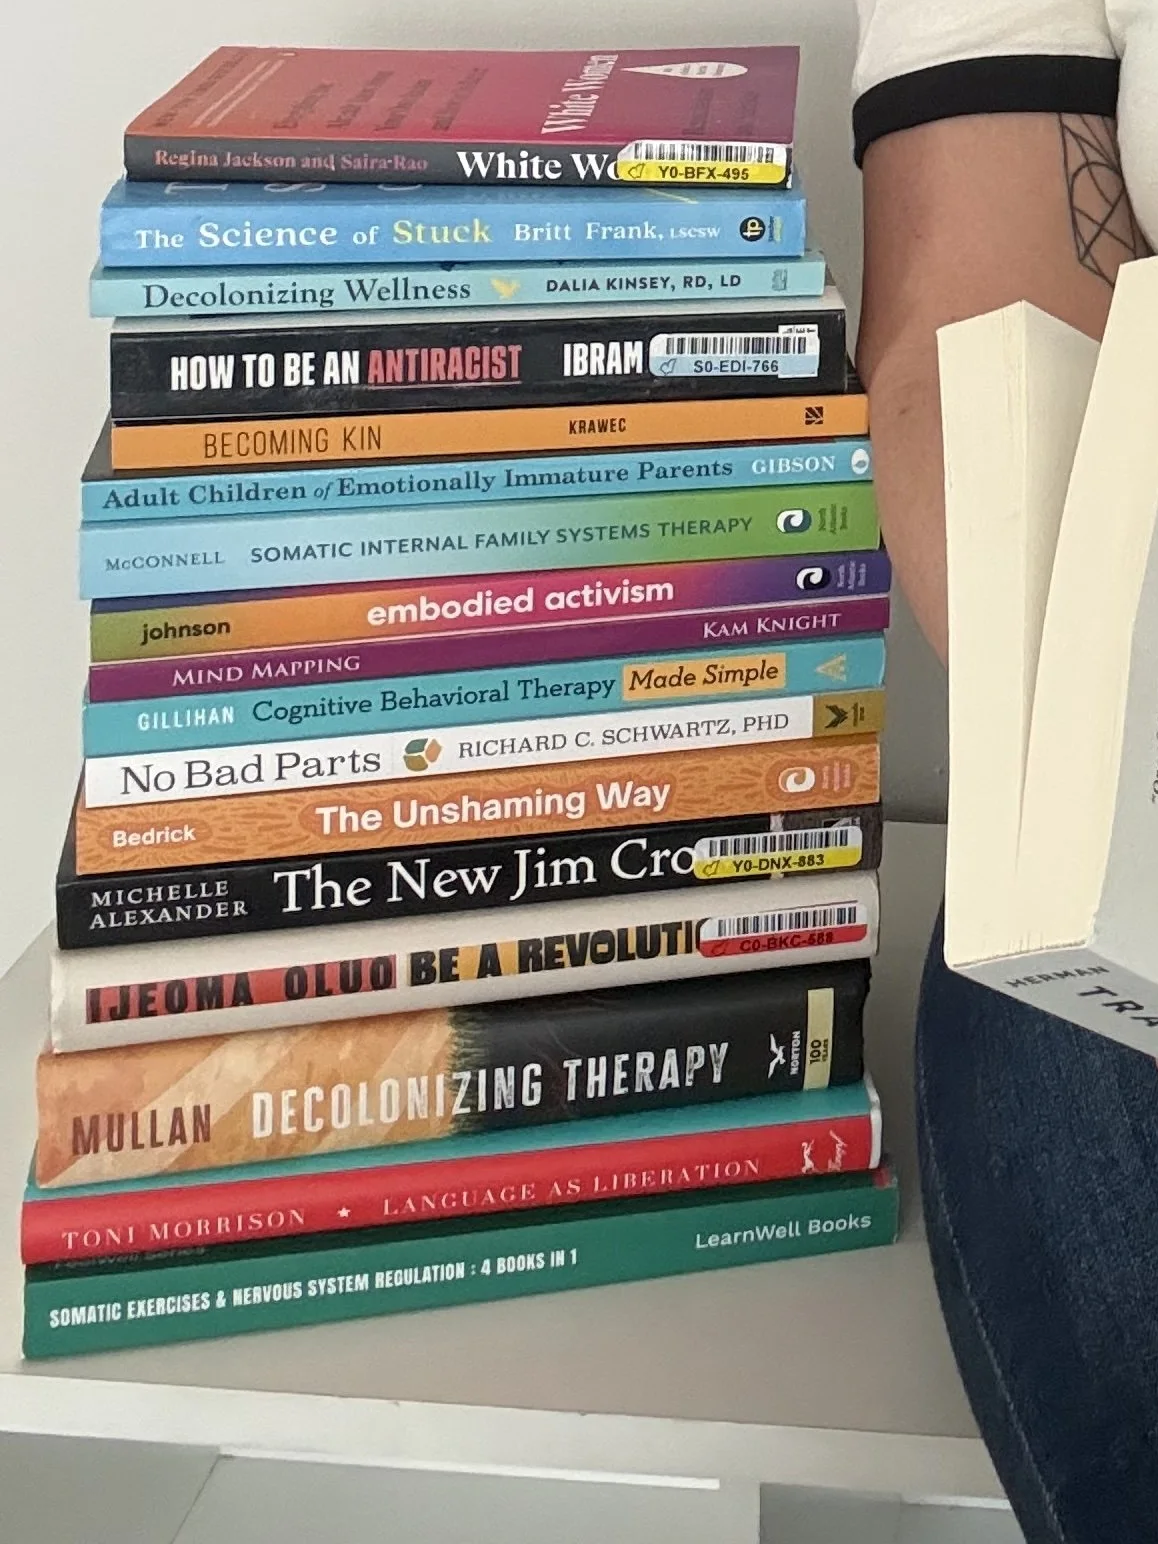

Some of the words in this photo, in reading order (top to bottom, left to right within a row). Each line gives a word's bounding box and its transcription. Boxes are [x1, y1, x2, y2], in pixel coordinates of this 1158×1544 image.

[541, 93, 600, 134] White
[154, 149, 218, 169] Regina
[223, 150, 296, 169] Jackson
[301, 151, 335, 171] and
[457, 149, 561, 181] White
[658, 166, 750, 181] Y0-BFX-495
[136, 229, 184, 249] The
[200, 221, 338, 248] Science
[353, 225, 379, 245] of
[393, 218, 493, 245] Stuck
[515, 223, 572, 242] Britt
[586, 221, 664, 243] Frank,
[143, 281, 334, 309] Decolonizing
[344, 277, 471, 302] Wellness
[546, 278, 600, 293] DALIA
[606, 275, 676, 293] KINSEY,
[682, 275, 713, 291] RD,
[720, 273, 742, 287] LD
[170, 355, 235, 391] HOW
[242, 353, 275, 388] TO
[283, 351, 316, 387] BE
[323, 350, 360, 385] AN
[367, 344, 522, 386] ANTIRACIST
[562, 340, 644, 377] IBRAM
[693, 359, 779, 373] S0-EDI-766
[204, 428, 329, 459] BECOMING
[343, 425, 382, 452] KIN
[569, 417, 627, 435] KRAWEC
[752, 455, 836, 474] GIBSON
[102, 487, 180, 509] Adult
[189, 482, 307, 505] Children
[313, 481, 334, 500] of
[337, 469, 496, 498] Emotionally
[505, 464, 629, 488] Immature
[637, 460, 733, 481] Parents
[251, 541, 353, 563] SOMATIC
[361, 535, 468, 557] INTERNAL
[475, 529, 550, 549] FAMILY
[556, 522, 650, 544] SYSTEMS
[658, 517, 754, 538] THERAPY
[367, 587, 534, 627] embodied
[544, 579, 674, 611] activism
[141, 619, 231, 646] johnson
[702, 619, 748, 639] KAM
[756, 613, 842, 634] KNIGHT
[172, 665, 243, 687] MIND
[251, 655, 360, 681] MAPPING
[252, 698, 372, 725] Cognitive
[380, 680, 508, 711] Behavioral
[517, 676, 617, 700] Therapy
[628, 665, 697, 691] Made
[702, 660, 779, 686] Simple
[137, 706, 234, 731] GILLIHAN
[459, 733, 566, 758] RICHARD
[574, 731, 595, 748] C.
[602, 720, 737, 746] SCHWARTZ,
[742, 713, 790, 733] PHD
[121, 765, 176, 795] No
[185, 754, 262, 789] Bad
[275, 748, 381, 781] Parts
[315, 805, 382, 835] The
[394, 788, 585, 829] Unshaming
[595, 779, 671, 811] Way
[112, 824, 196, 848] Bedrick
[273, 863, 372, 914] The
[386, 858, 502, 904] New
[509, 846, 597, 902] Jim
[610, 838, 697, 881] Cro
[91, 880, 229, 908] MICHELLE
[89, 899, 249, 930] ALEXANDER
[410, 948, 460, 987] BE
[476, 943, 502, 979] A
[518, 918, 707, 973] REVOLUTI
[88, 971, 255, 1023] IJEOMA
[284, 955, 394, 1001] OLUO
[1006, 965, 1110, 989] HERMAN
[790, 1030, 801, 1075] NORTON
[809, 1039, 822, 1065] 100
[252, 1062, 542, 1139] DECOLONIZING
[563, 1042, 729, 1102] THERAPY
[71, 1104, 212, 1156] MULLAN
[383, 1183, 535, 1216] LANGUAGE
[549, 1179, 581, 1198] AS
[593, 1159, 760, 1192] LIBERATION
[61, 1226, 134, 1250] TONI
[150, 1207, 306, 1240] MORRISON
[695, 1220, 801, 1250] LearnWell
[808, 1213, 872, 1236] Books
[49, 1302, 122, 1328] SOMATIC
[127, 1291, 210, 1319] EXERCISES
[215, 1289, 227, 1308] &
[233, 1280, 302, 1308] NERVOUS
[307, 1273, 369, 1297] SYSTEM
[375, 1261, 465, 1289] REGULATION
[480, 1259, 491, 1276] 4
[496, 1252, 545, 1275] BOOKS
[550, 1250, 565, 1268] IN
[570, 1248, 578, 1265] 1
